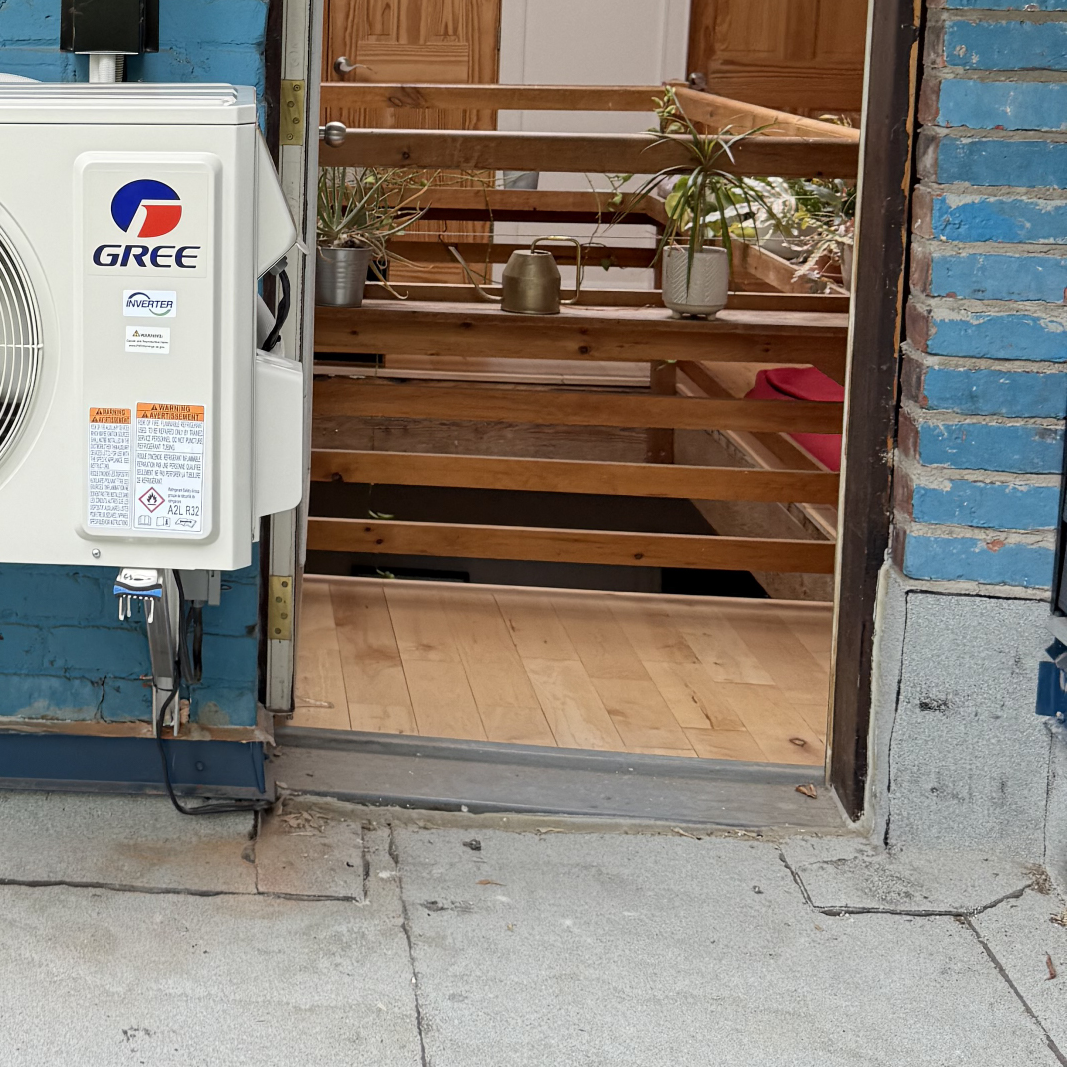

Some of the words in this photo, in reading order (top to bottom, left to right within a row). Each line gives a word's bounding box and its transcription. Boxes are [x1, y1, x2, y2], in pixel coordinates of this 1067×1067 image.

[93, 244, 201, 268] GREE
[126, 299, 173, 308] INVERTER
[159, 404, 190, 412] WARNING
[150, 412, 199, 421] AVERTISSEMENT
[167, 505, 183, 515] A2L
[186, 506, 199, 516] R32
